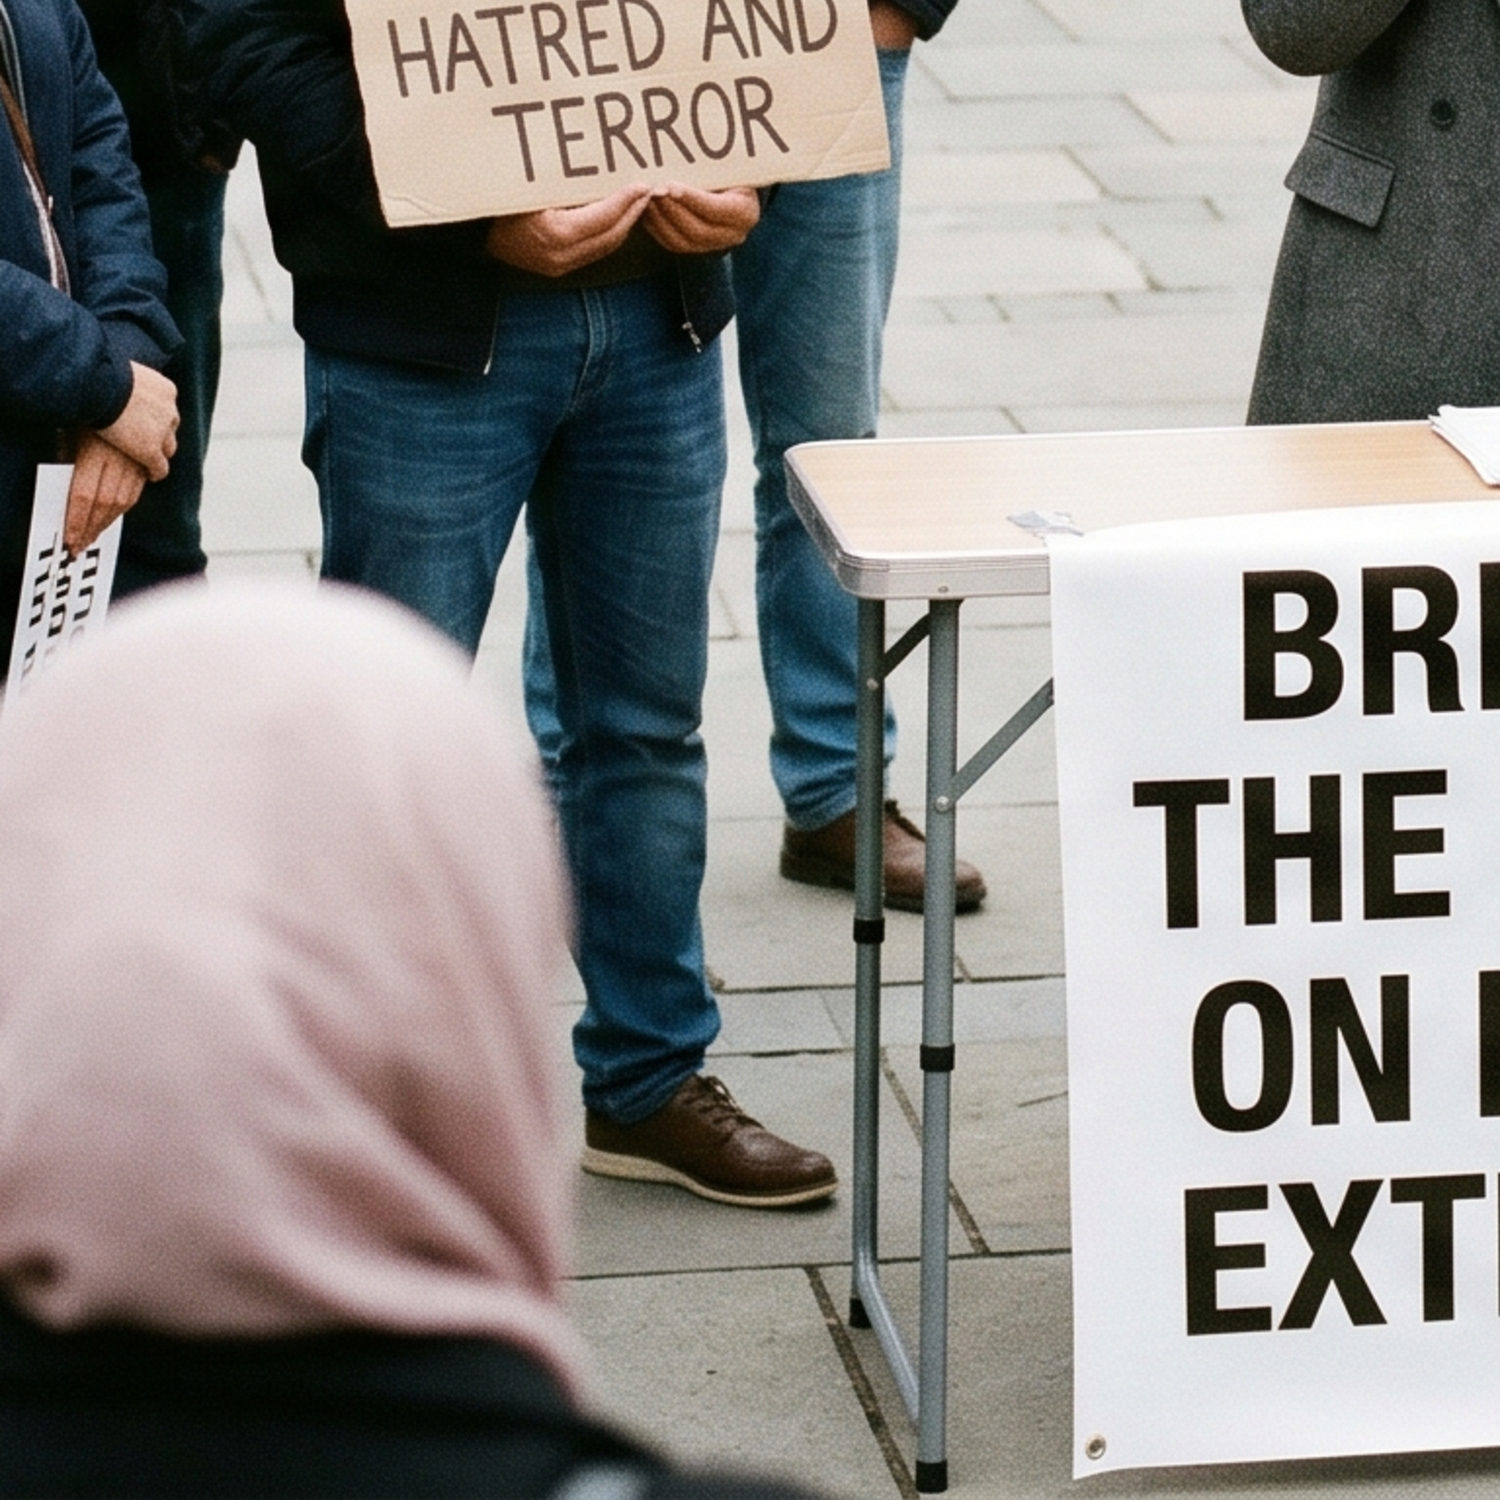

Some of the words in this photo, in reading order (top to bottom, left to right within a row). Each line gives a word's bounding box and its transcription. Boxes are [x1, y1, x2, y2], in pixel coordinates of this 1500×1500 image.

[492, 76, 789, 182] TERROR
[1132, 769, 1451, 929] THE
[1192, 974, 1411, 1133] ON
